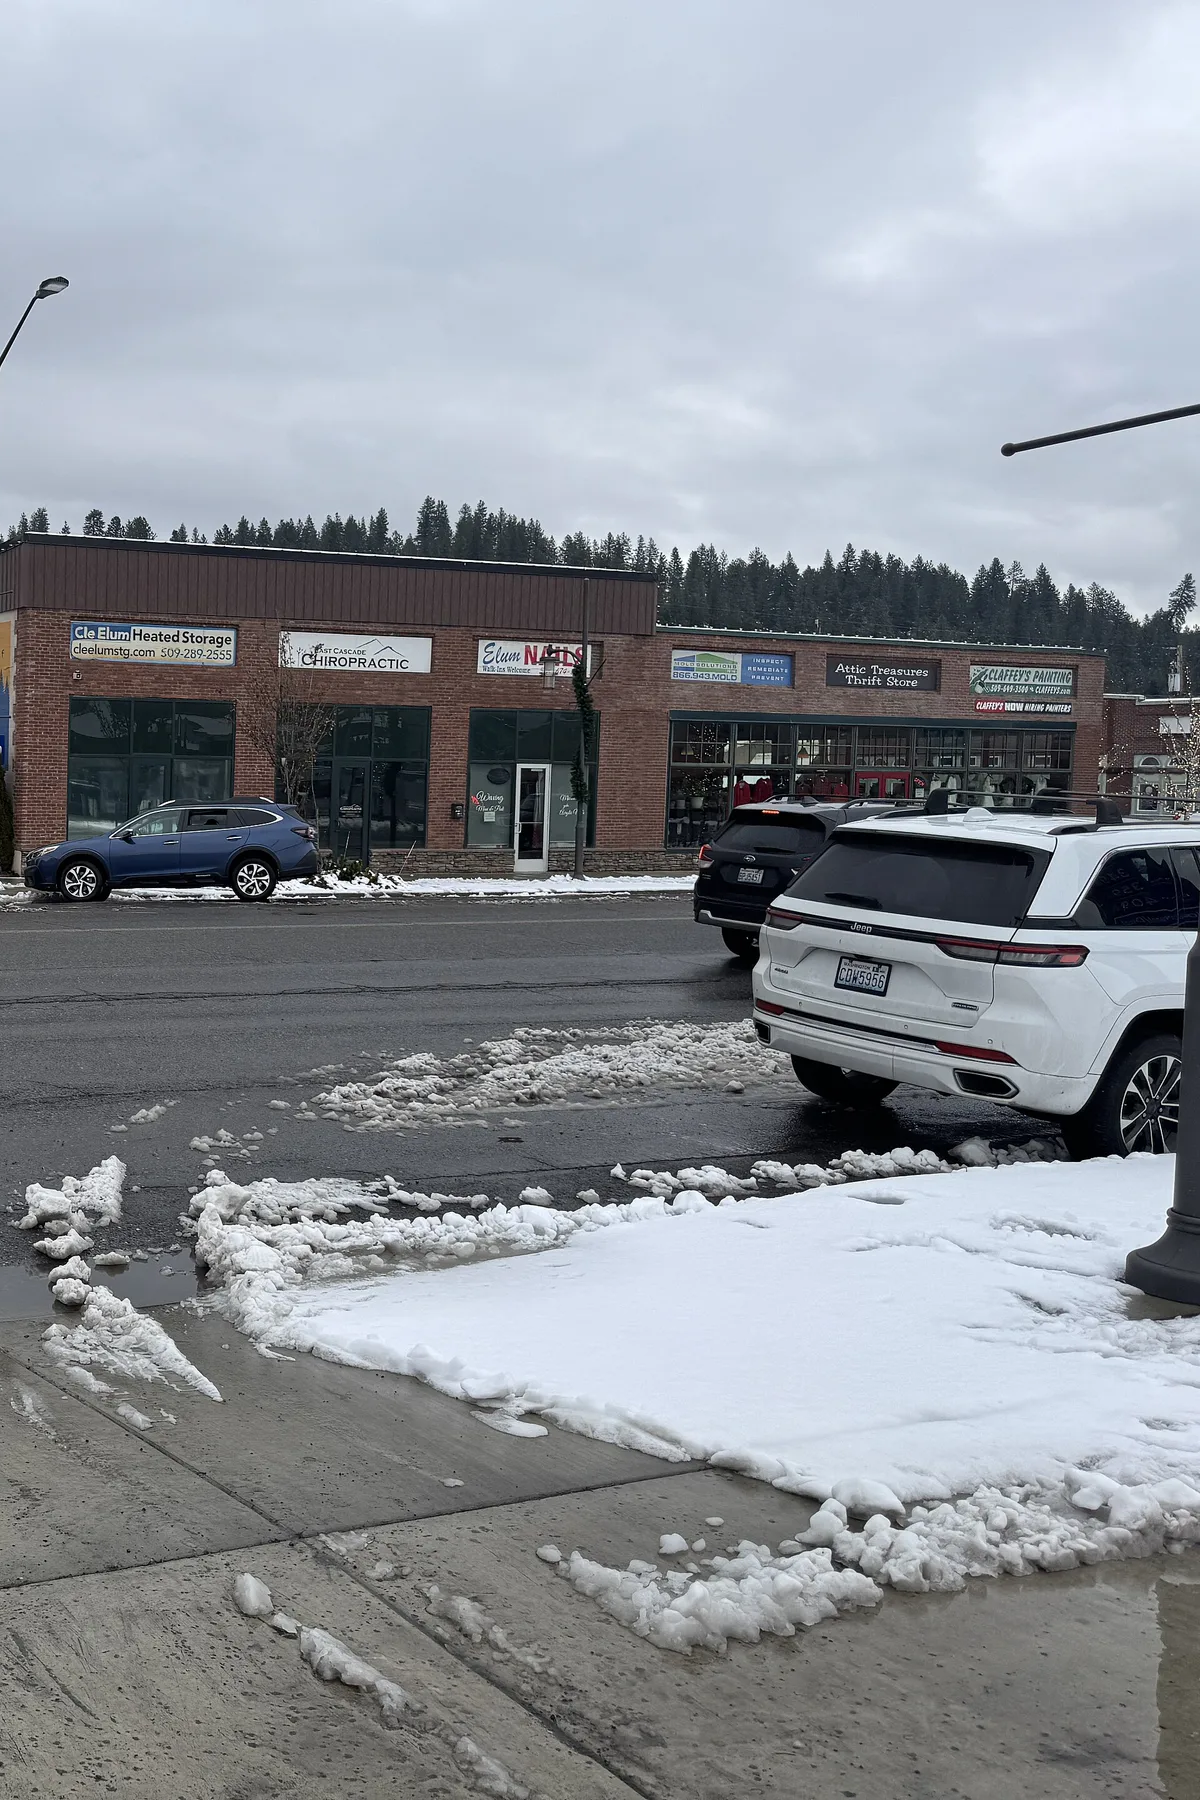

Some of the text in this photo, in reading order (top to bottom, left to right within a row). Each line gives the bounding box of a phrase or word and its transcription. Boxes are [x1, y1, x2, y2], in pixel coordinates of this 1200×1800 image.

[74, 626, 232, 648] Cle Elum Heated Storage
[74, 644, 232, 660] cleelumstg.com 509-289-2555
[482, 642, 521, 664] Elum
[302, 654, 409, 669] CHIROPRACTIC
[835, 664, 929, 677] Attic Treasures
[988, 669, 1072, 684] CLAFFEY'S PAINTING
[846, 675, 918, 686] Thrift Store
[976, 702, 1071, 712] CLAFFEY'S NOW HIRING PAINTERS
[850, 922, 872, 933] Jeep
[839, 968, 885, 988] CDW5956
